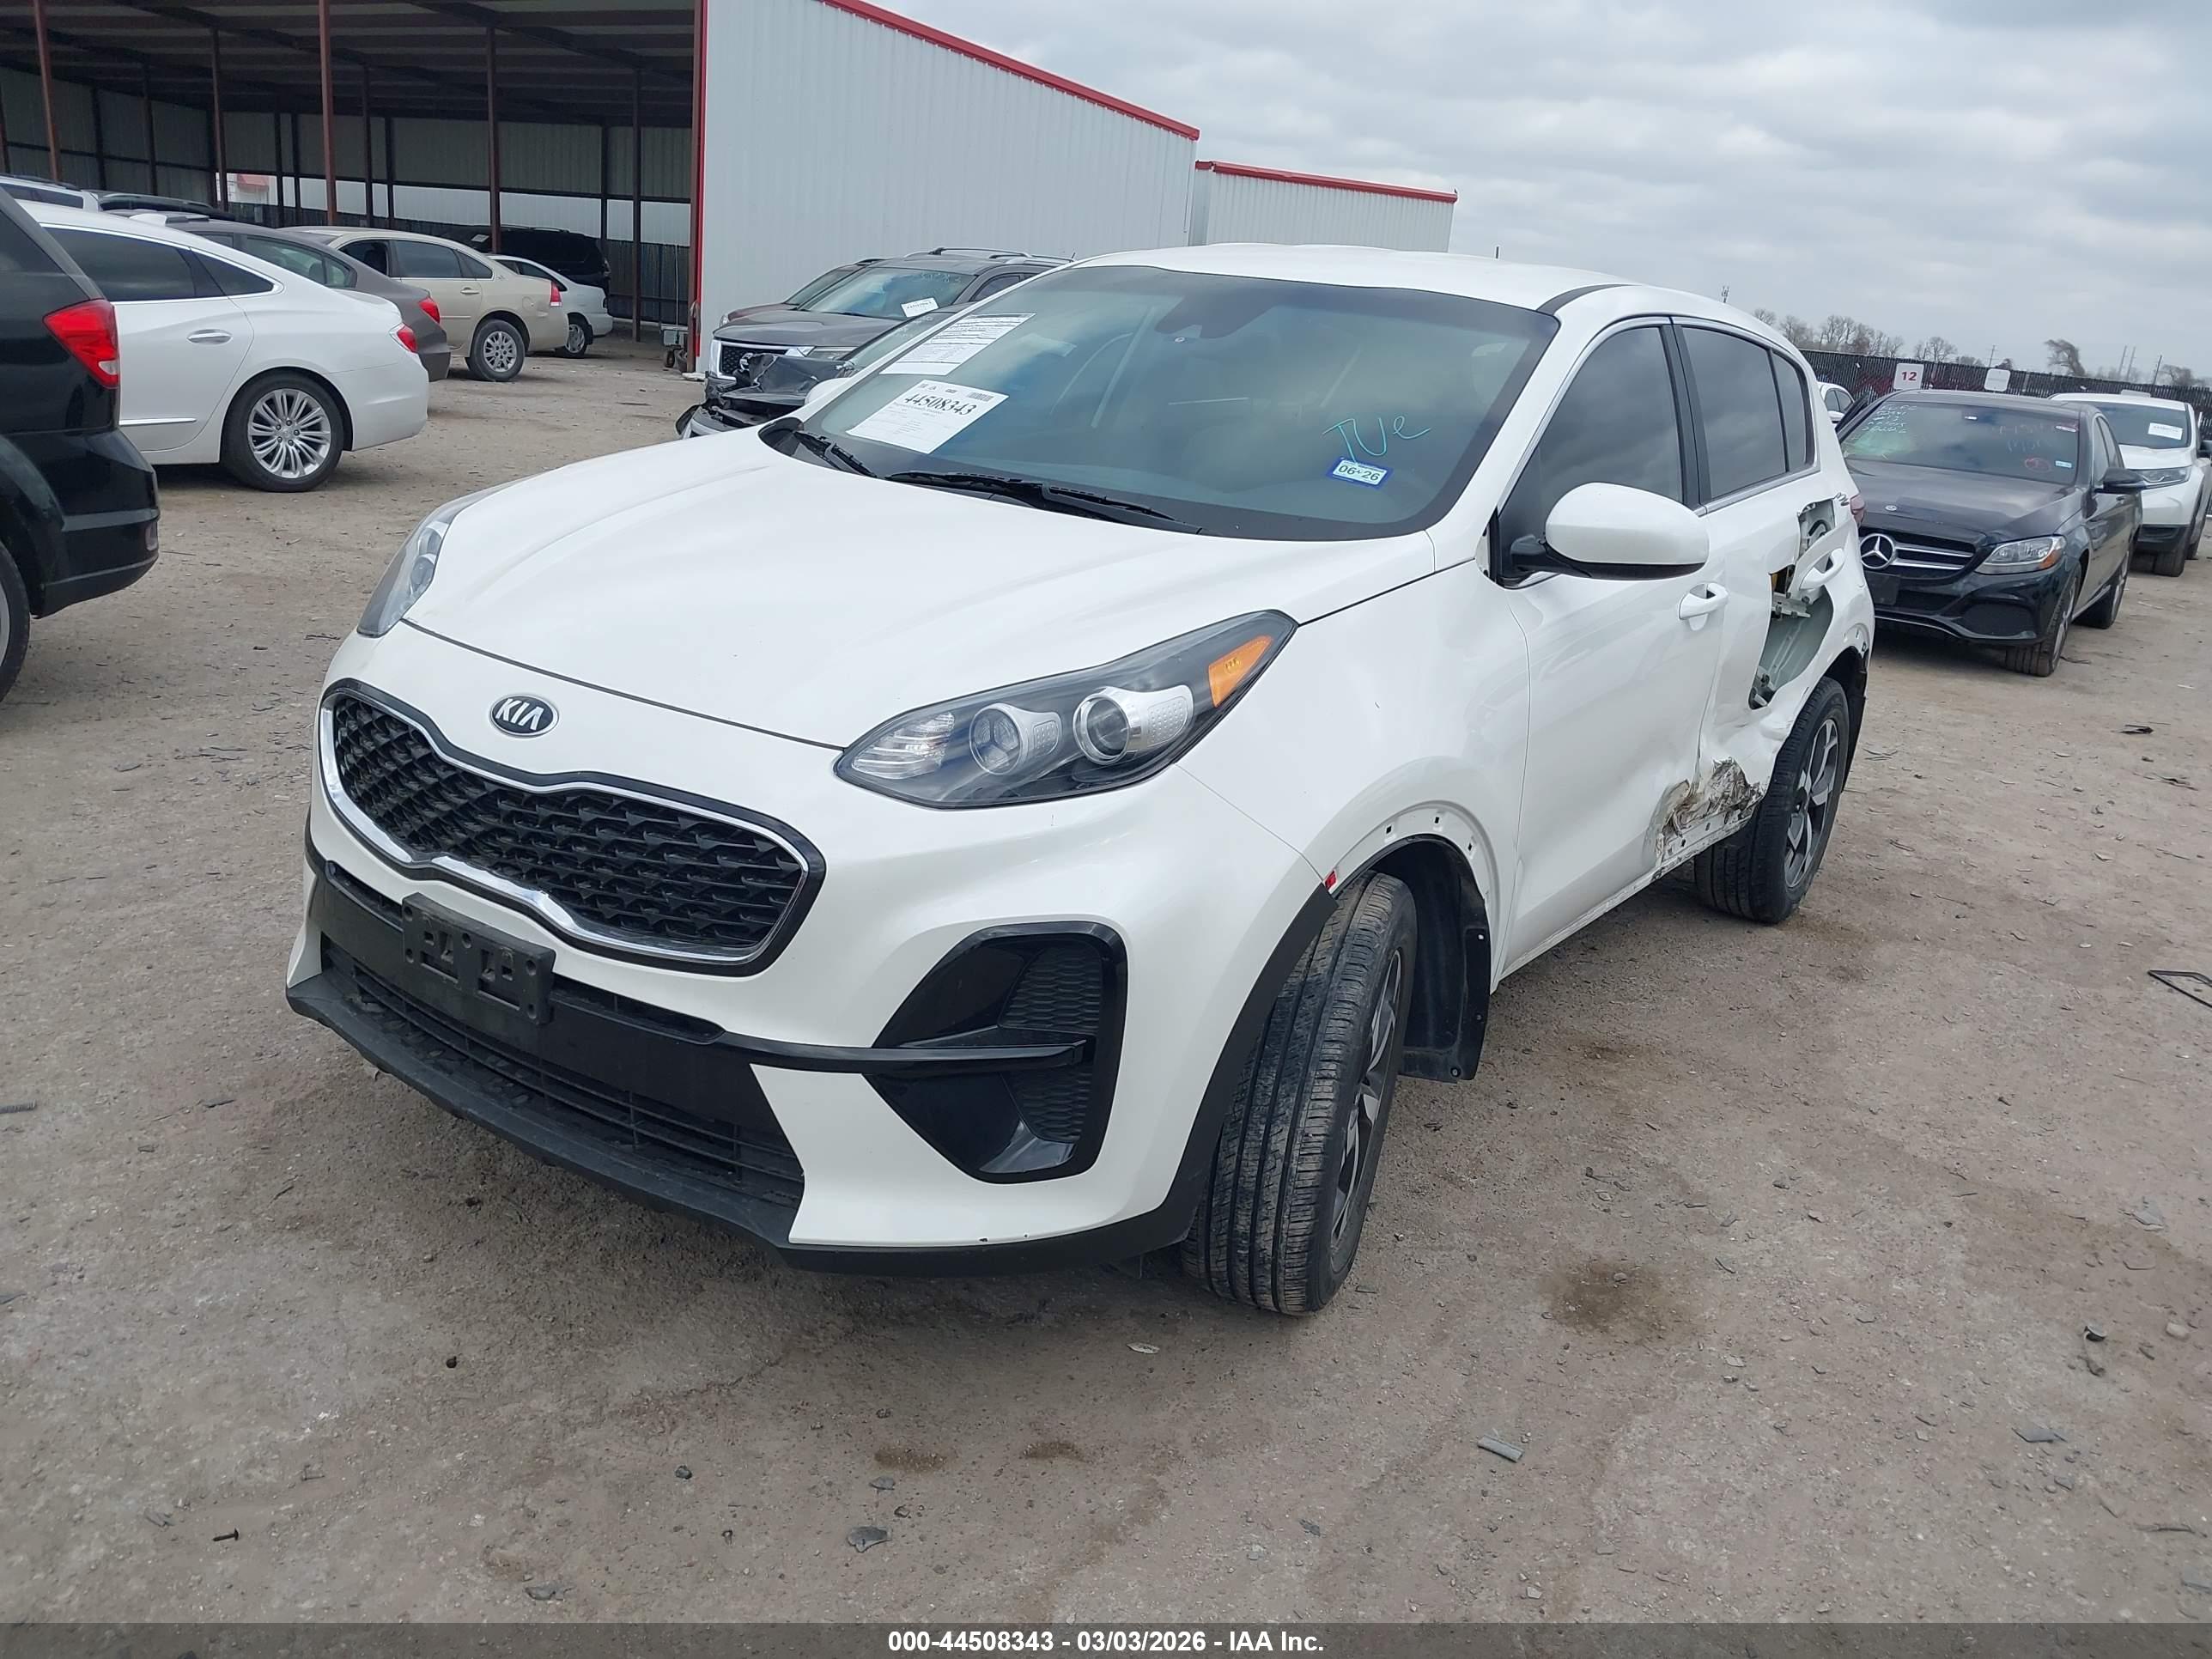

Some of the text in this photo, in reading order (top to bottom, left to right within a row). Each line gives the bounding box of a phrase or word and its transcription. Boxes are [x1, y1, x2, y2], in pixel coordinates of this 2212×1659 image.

[1901, 371, 1917, 381] 12
[904, 393, 977, 416] 44508343
[1338, 465, 1381, 482] 06 26
[495, 697, 544, 731] KIA
